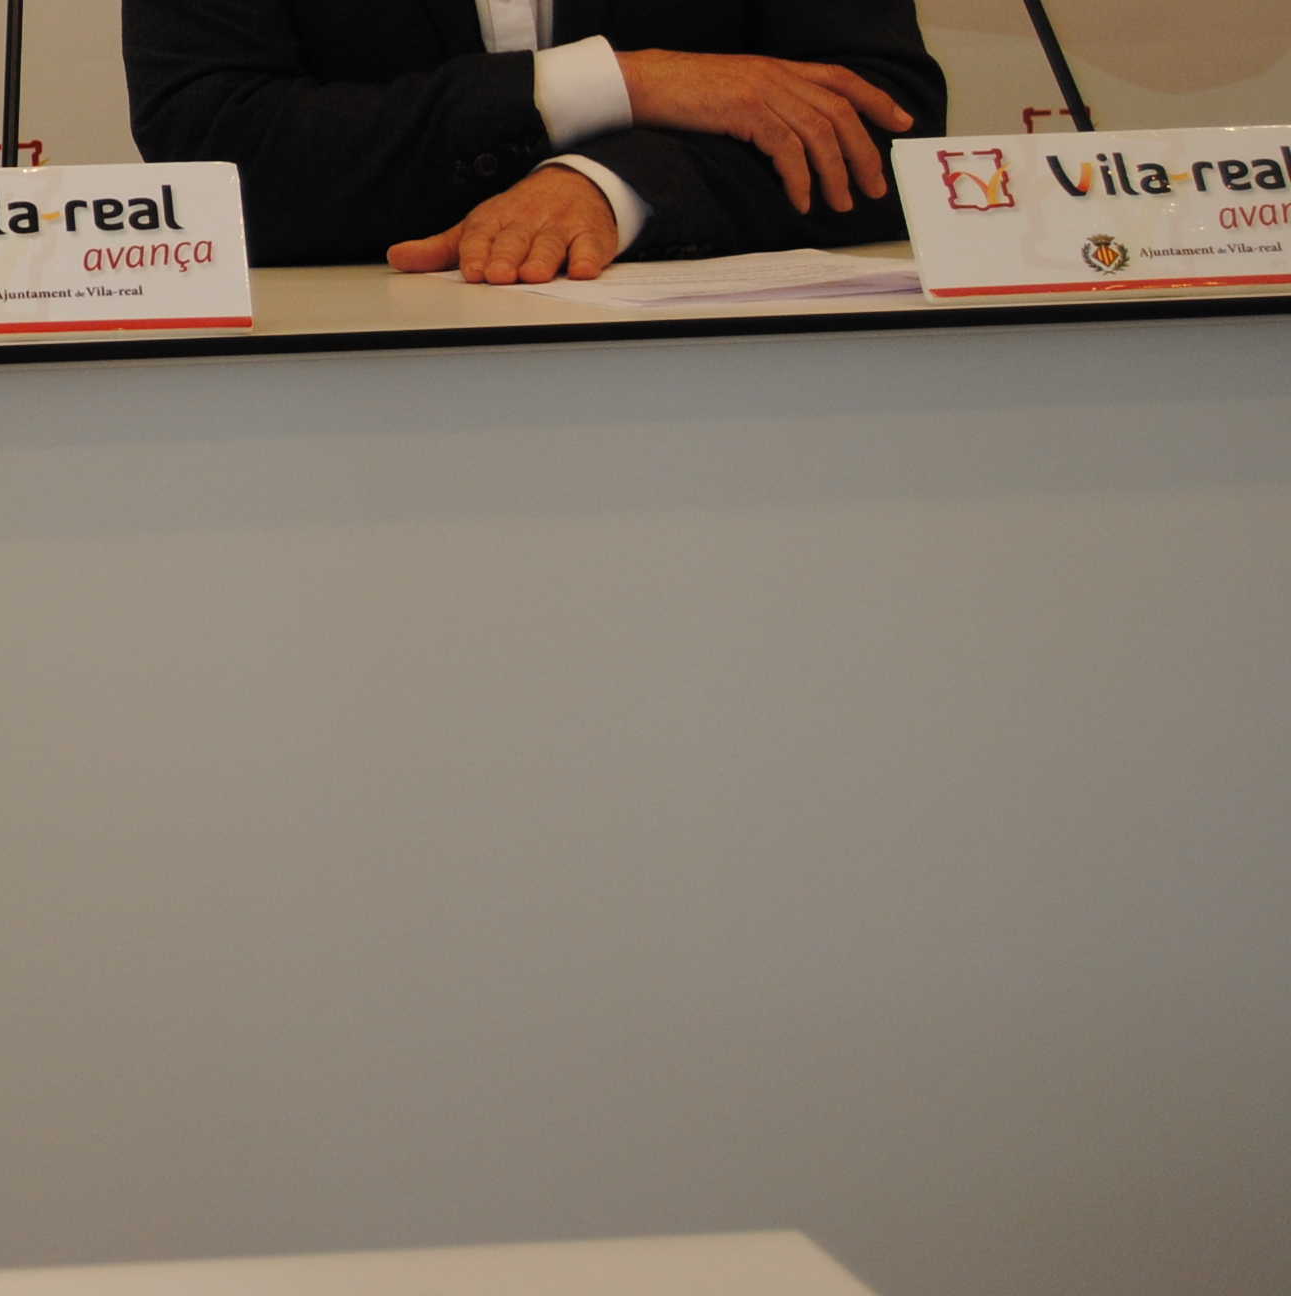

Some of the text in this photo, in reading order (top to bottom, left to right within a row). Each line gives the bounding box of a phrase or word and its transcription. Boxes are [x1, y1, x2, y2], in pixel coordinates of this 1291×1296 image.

[83, 239, 214, 272] avança
[1139, 245, 1215, 259] Ajuntament
[1227, 242, 1283, 254] Vila-real
[86, 285, 143, 298] Vila-real
